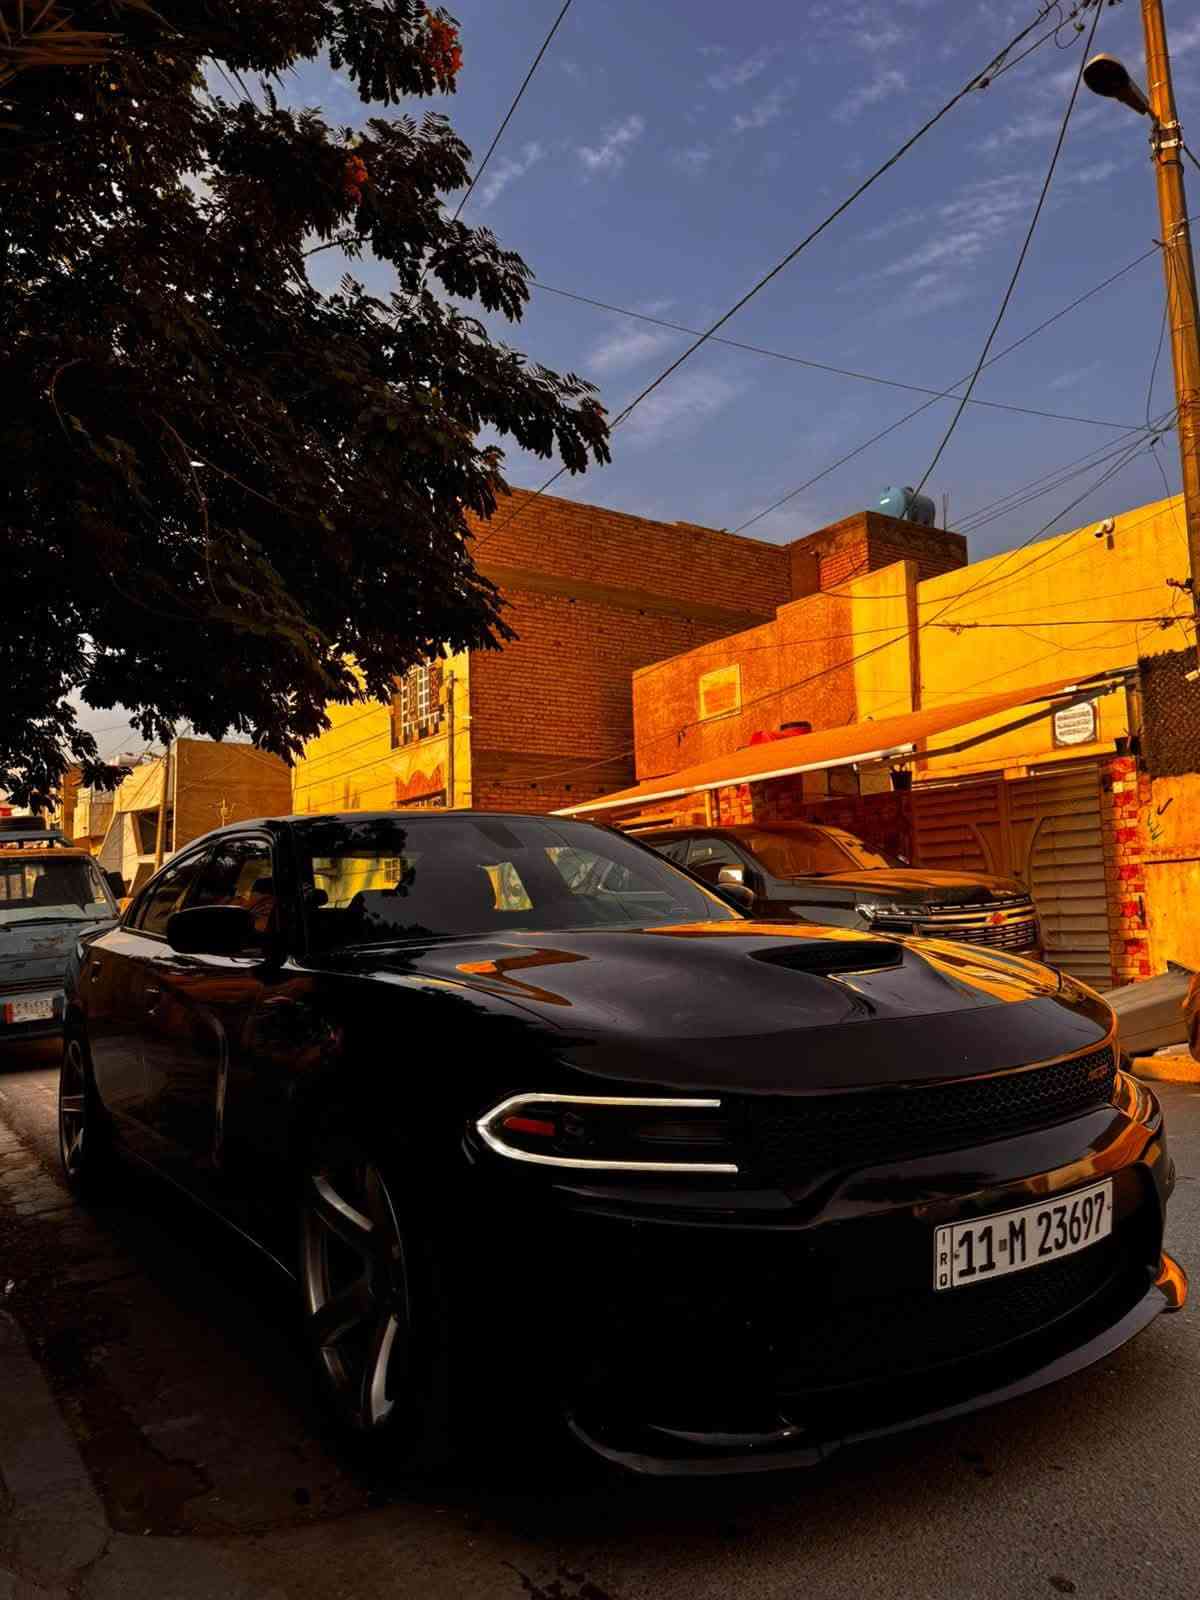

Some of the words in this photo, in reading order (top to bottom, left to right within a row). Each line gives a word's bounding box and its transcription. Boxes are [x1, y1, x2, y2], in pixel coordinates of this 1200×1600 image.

[958, 1226, 996, 1278] 11
[1008, 1217, 1027, 1265] M
[1037, 1191, 1105, 1257] 23697
